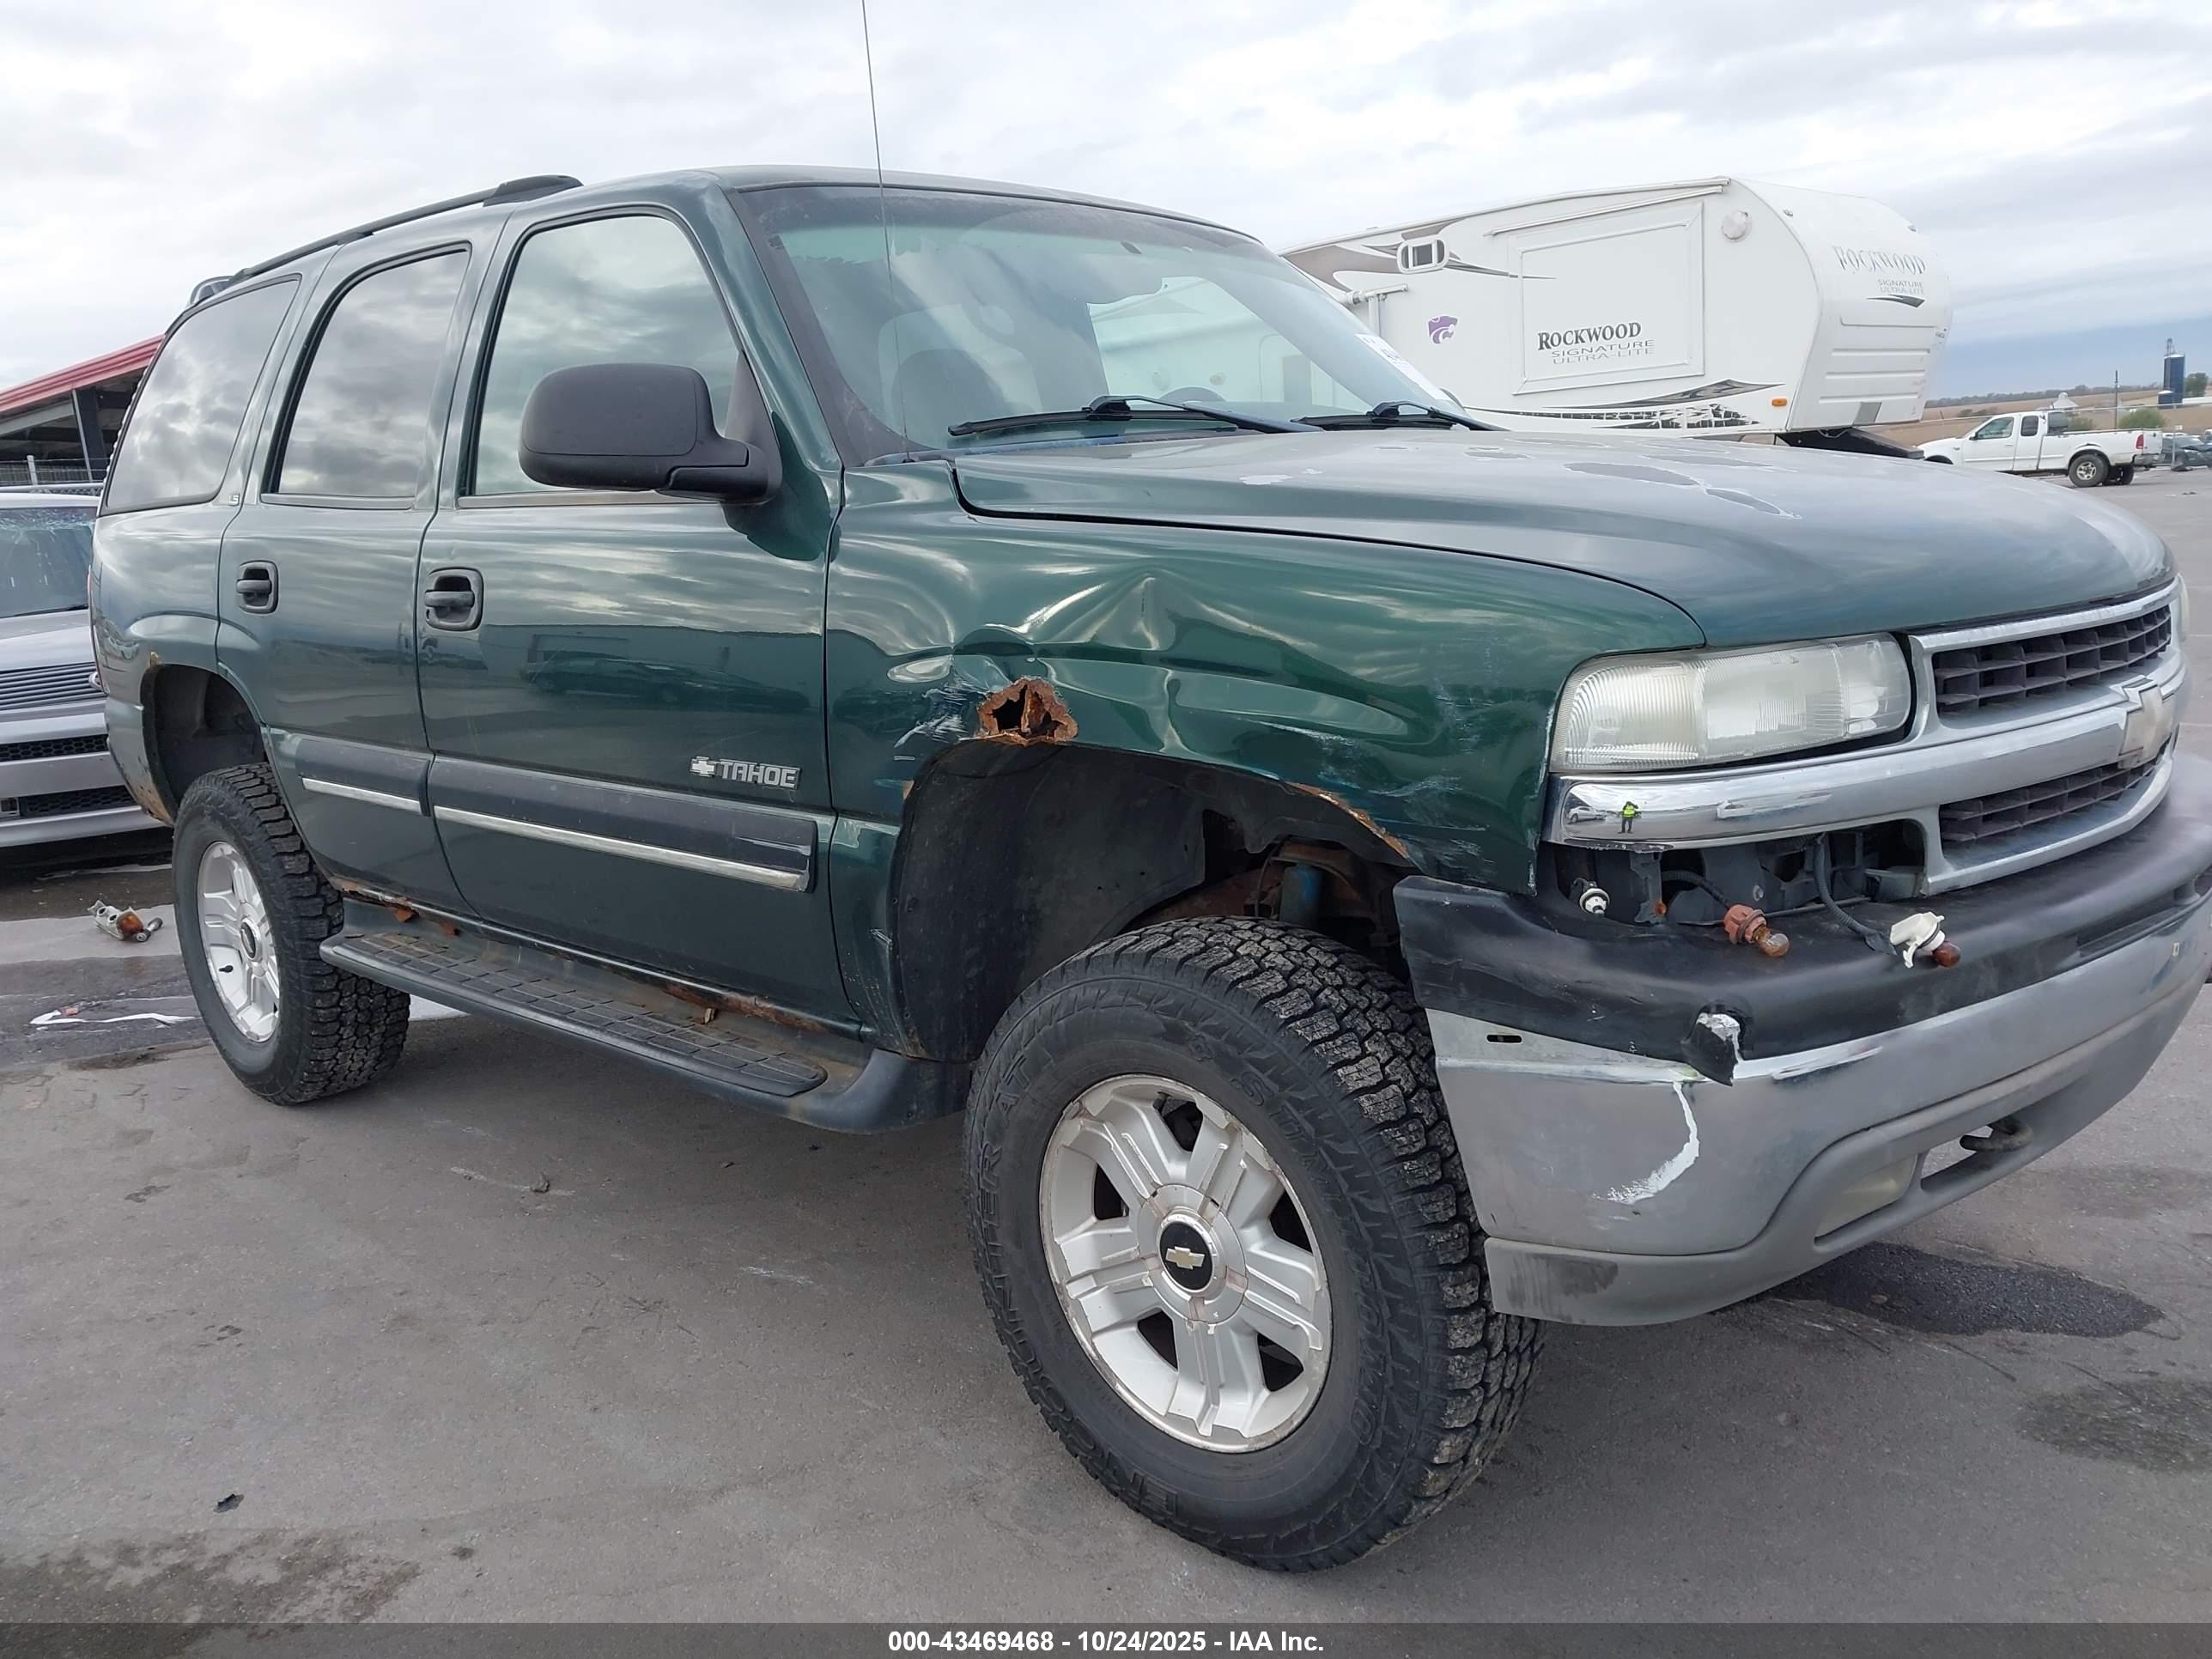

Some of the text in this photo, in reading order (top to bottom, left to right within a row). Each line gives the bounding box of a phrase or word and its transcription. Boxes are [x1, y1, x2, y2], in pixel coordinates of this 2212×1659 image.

[1877, 279, 1923, 289] SIGNATURE
[1537, 321, 1642, 351] ROCKWOOD
[1551, 339, 1656, 358] SIGNATURE
[1553, 347, 1655, 365] ULTRA-LITE
[720, 760, 797, 787] TAHOE
